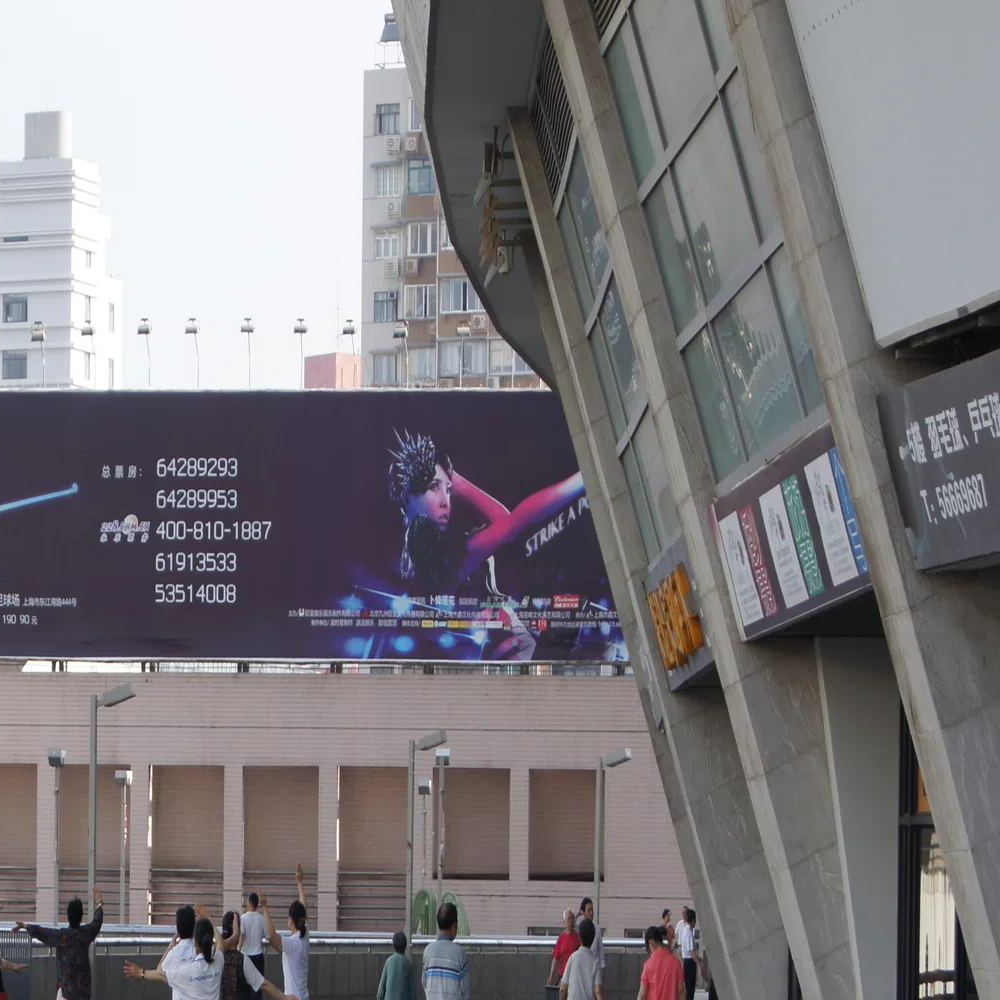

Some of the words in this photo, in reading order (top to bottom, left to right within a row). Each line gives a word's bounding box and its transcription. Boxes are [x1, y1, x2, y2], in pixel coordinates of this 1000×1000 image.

[156, 457, 239, 477] 64289293
[156, 489, 238, 509] 64289953
[935, 473, 988, 520] 56669687
[155, 521, 272, 540] 400-810-1887
[525, 512, 565, 557] STRIKE
[567, 505, 576, 525] A
[155, 552, 237, 572] 61913533
[154, 583, 237, 604] 53514008
[2, 614, 17, 625] 190
